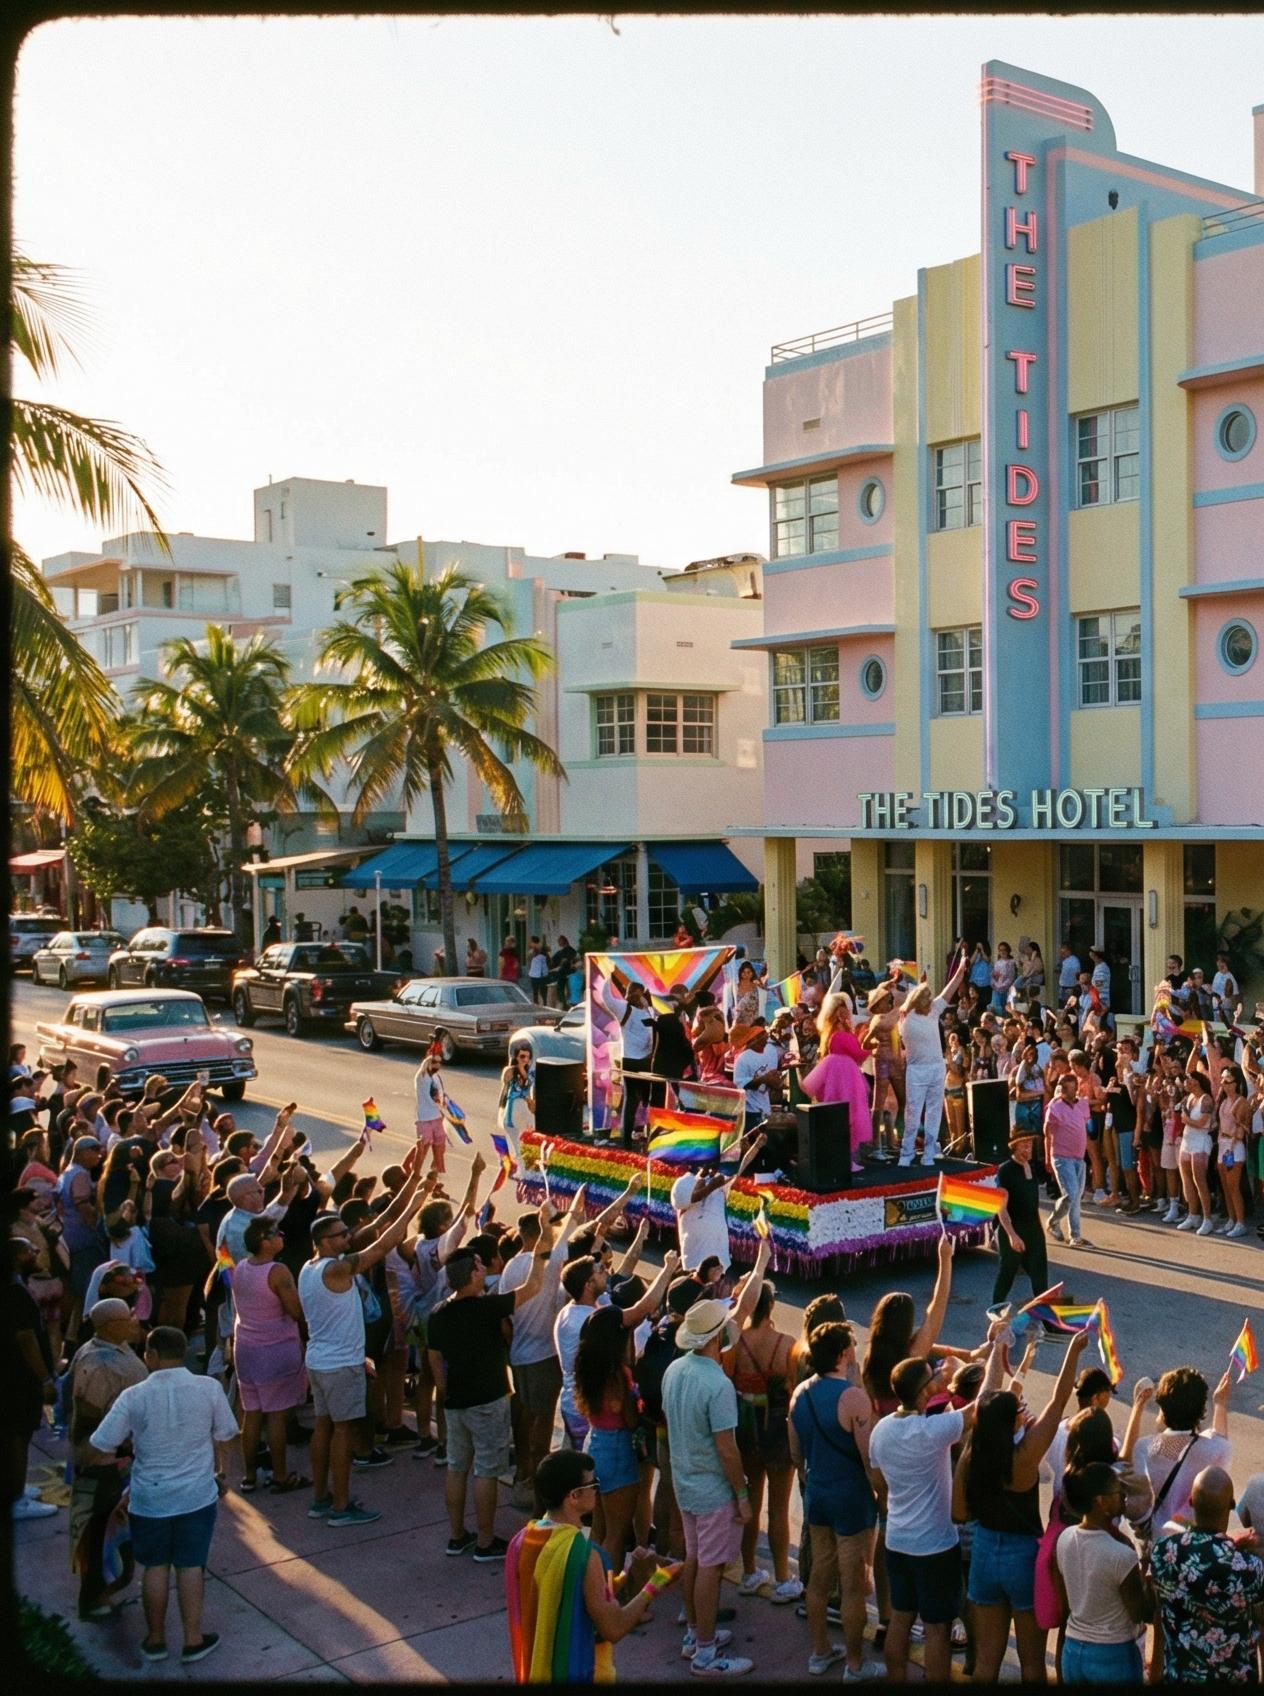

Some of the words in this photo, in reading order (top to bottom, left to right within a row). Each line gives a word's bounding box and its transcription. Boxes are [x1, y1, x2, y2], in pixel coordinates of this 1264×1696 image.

[1005, 150, 1037, 308] THE
[1006, 350, 1039, 621] TIDES
[857, 792, 911, 829] THE
[923, 790, 1017, 829] TIDES
[1032, 787, 1158, 829] HOTEL
